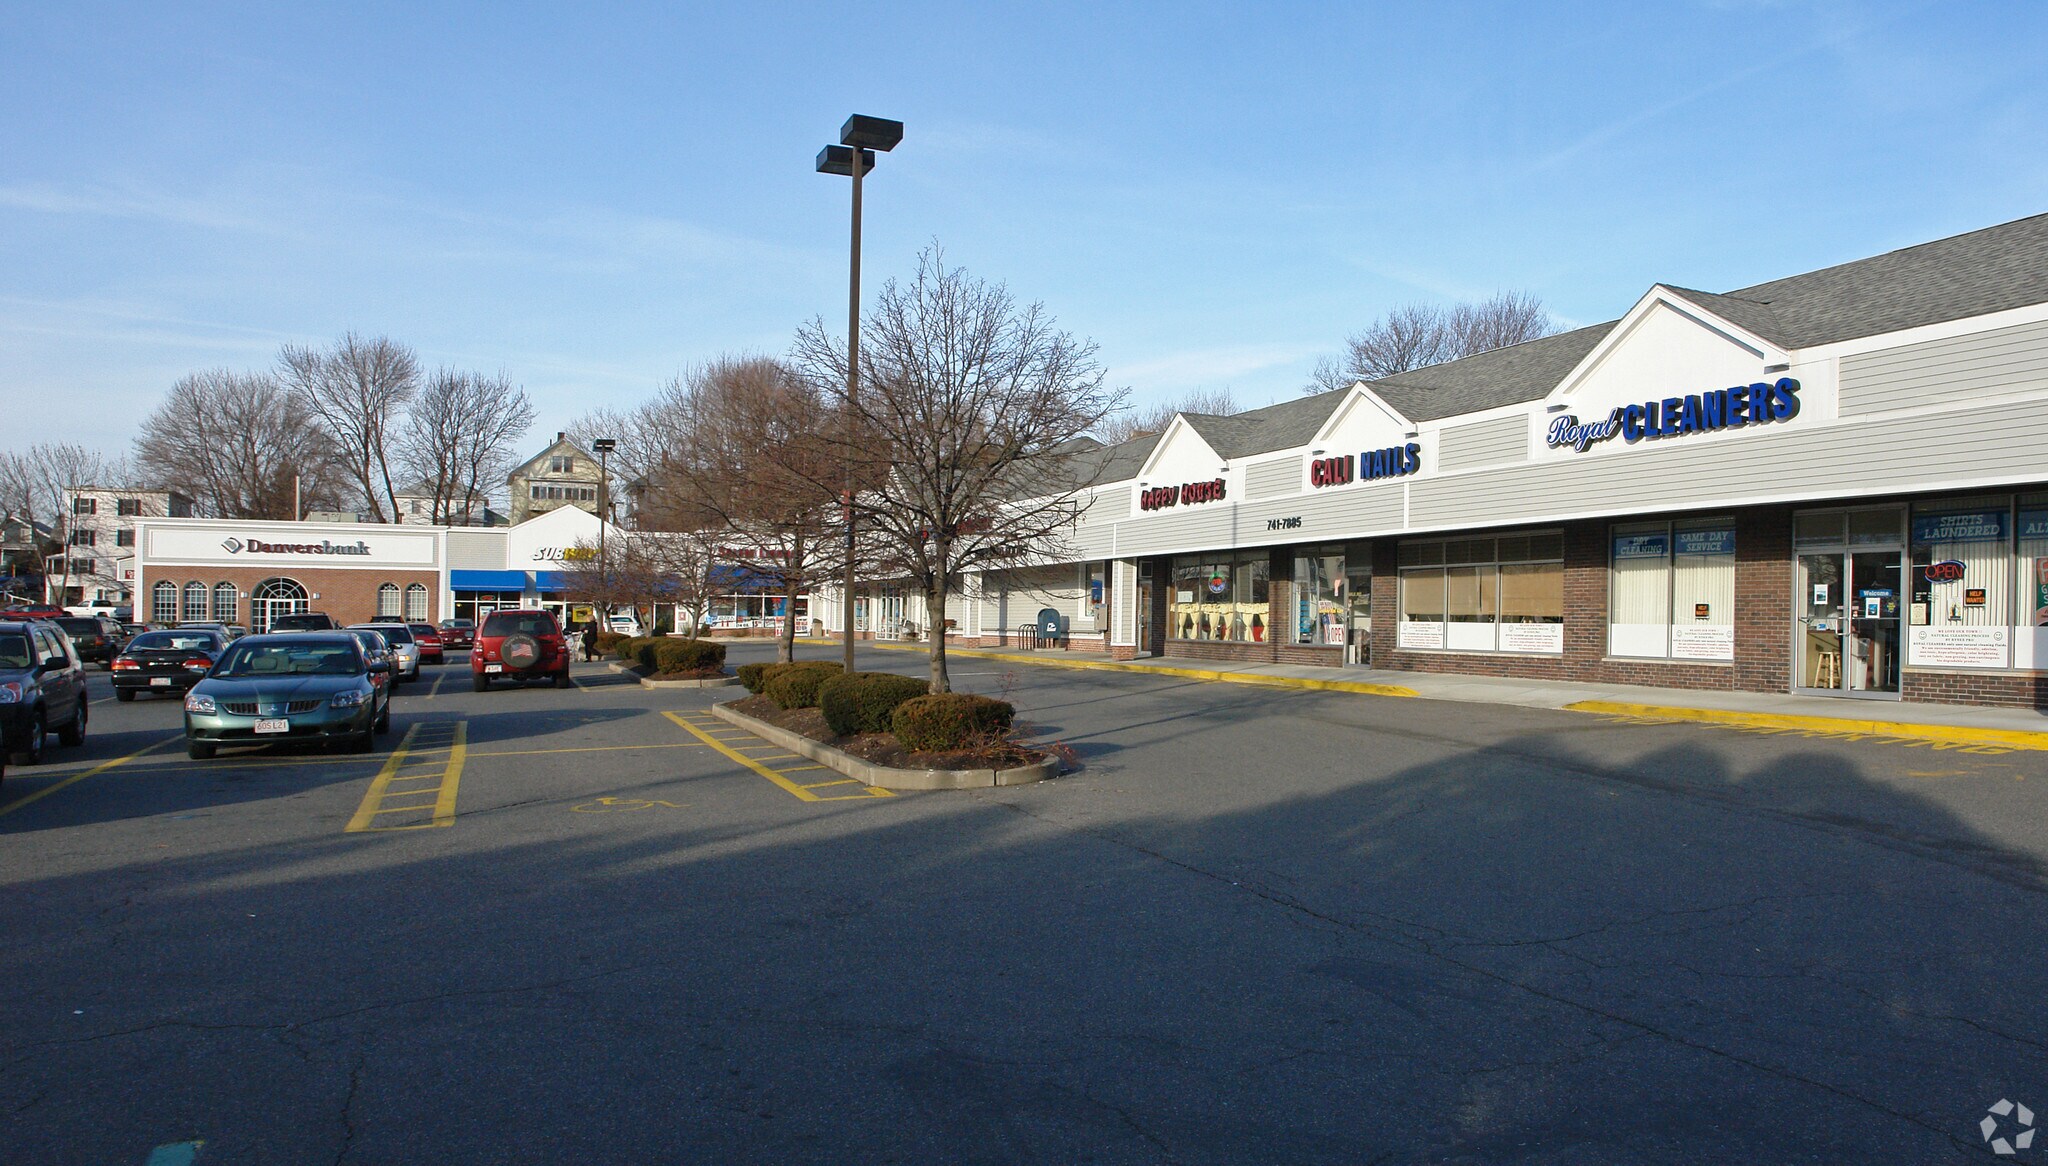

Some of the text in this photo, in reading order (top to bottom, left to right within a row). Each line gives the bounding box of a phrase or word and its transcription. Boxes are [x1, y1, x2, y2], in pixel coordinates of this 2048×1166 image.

[1547, 377, 1800, 452] Royal CLEANERS
[1311, 443, 1420, 487] CALI NAILS
[1141, 478, 1226, 511] HAPPY HOUSE
[1940, 515, 1983, 527] SHIRTS
[1681, 531, 1729, 543] SAME DAY
[1924, 525, 2000, 539] LAUNDERED
[246, 538, 371, 556] Danversbank
[1621, 545, 1663, 555] CLEANING
[1686, 542, 1722, 552] SERVICE
[1925, 564, 1963, 578] OPEN
